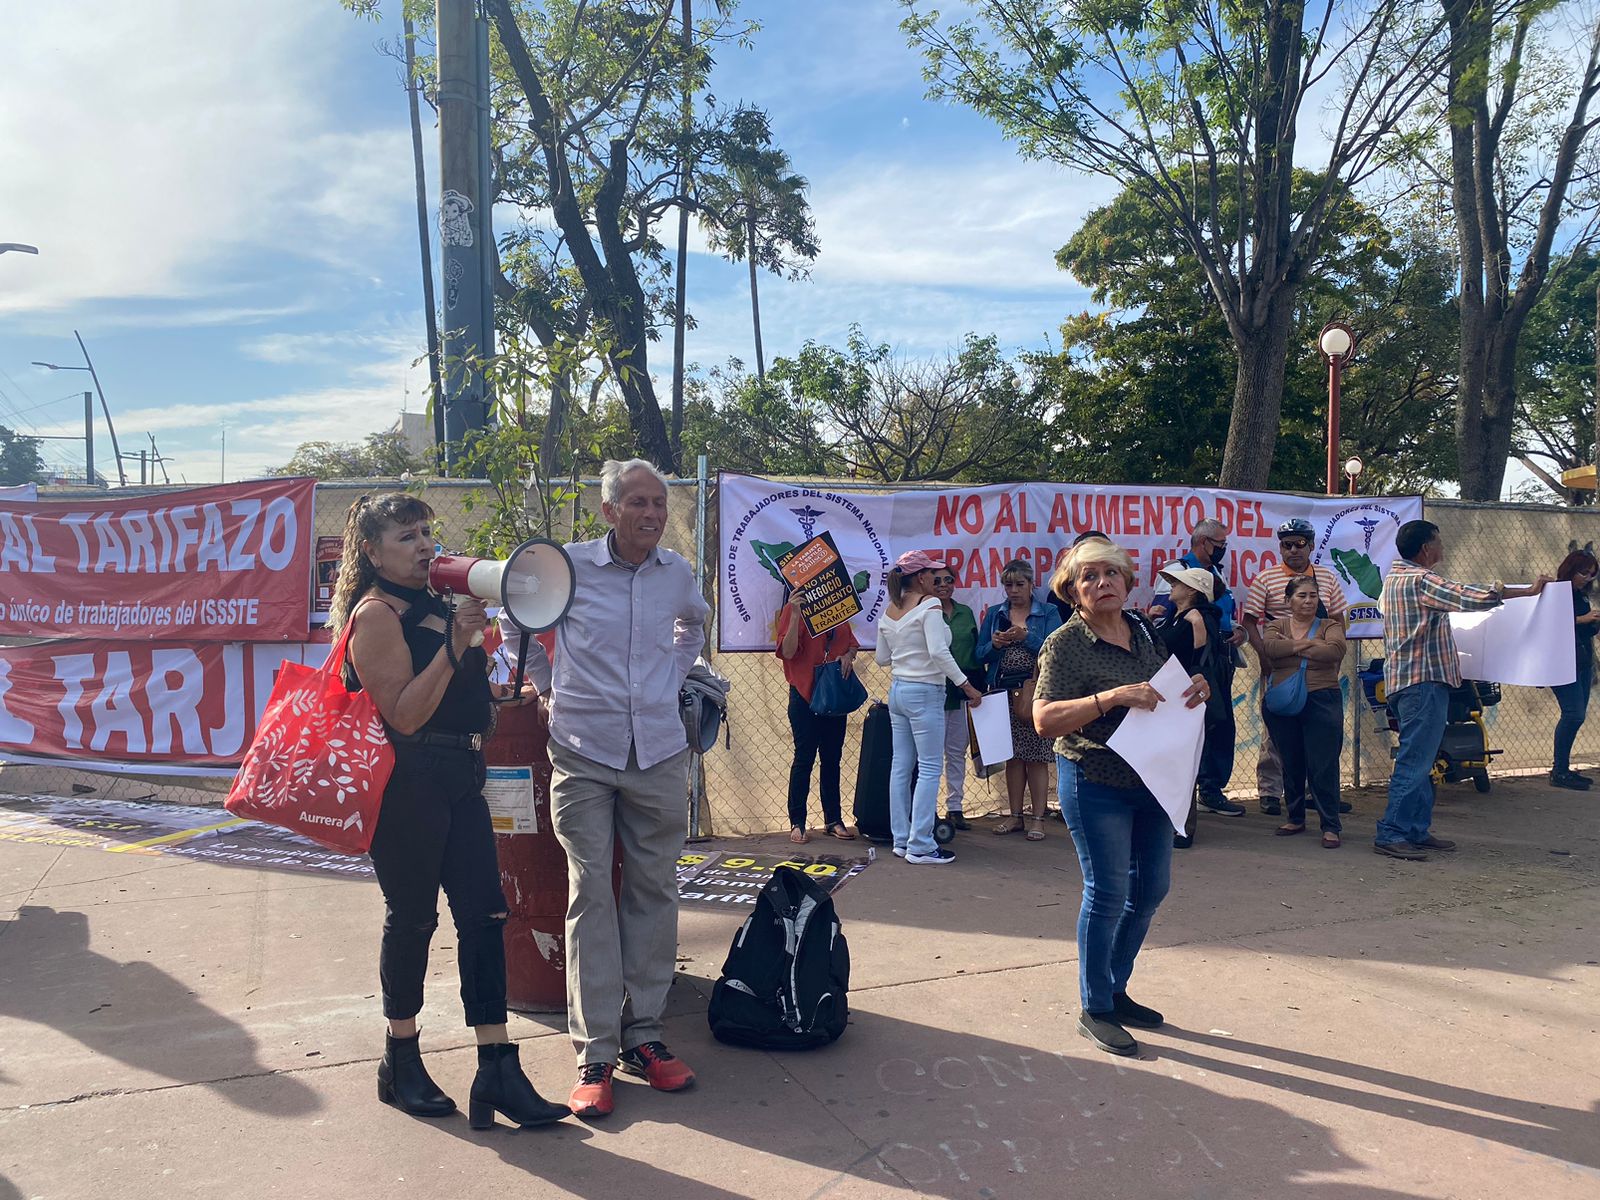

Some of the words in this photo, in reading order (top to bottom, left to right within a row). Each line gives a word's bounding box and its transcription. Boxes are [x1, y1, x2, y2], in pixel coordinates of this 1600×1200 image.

[802, 489, 822, 498] DEL
[825, 492, 864, 521] SISTEMA
[733, 489, 799, 542] TRABAJADORES
[934, 494, 985, 536] NO
[993, 492, 1037, 534] AL
[1047, 493, 1206, 536] AUMENTO
[1215, 497, 1273, 538] DEL
[0, 511, 56, 573] AL
[59, 496, 298, 573] TARIFAZO
[862, 520, 890, 569] NACIONAL
[1314, 551, 1322, 565] DE
[1374, 504, 1401, 527] SISTEMA
[729, 544, 738, 560] DE
[780, 552, 794, 568] SIN
[728, 563, 751, 622] SINDICATO
[804, 579, 818, 590] NO
[819, 568, 837, 583] HAY
[805, 576, 843, 603] NEGOCIO
[880, 572, 889, 587] DE
[10, 597, 50, 624] único
[54, 600, 74, 625] de
[78, 600, 171, 632] trabajadores
[175, 599, 196, 625] del
[201, 598, 259, 625] ISSSTE
[802, 608, 812, 618] NI
[813, 585, 853, 615] AUMENTO
[820, 609, 834, 620] NO
[835, 602, 847, 611] LA
[866, 589, 886, 622] SALUD
[1350, 607, 1384, 621] STSN
[814, 604, 857, 630] TRAMITES
[299, 811, 344, 828] Aurrera
[266, 854, 302, 865] de
